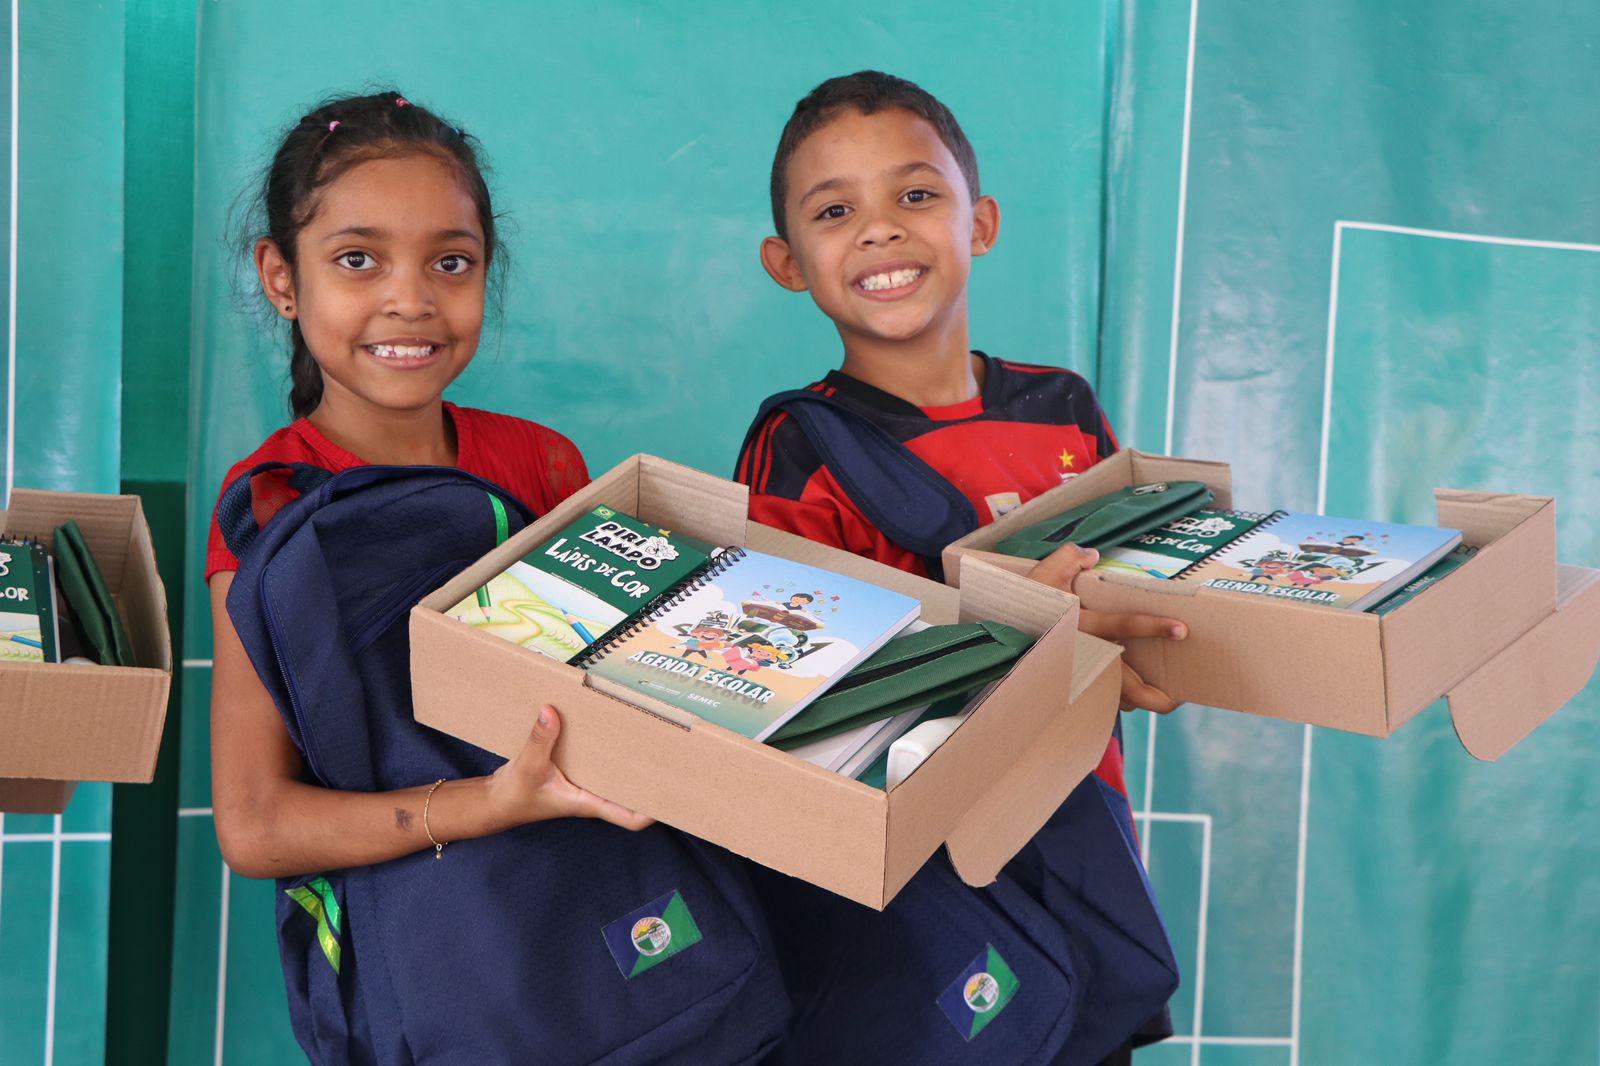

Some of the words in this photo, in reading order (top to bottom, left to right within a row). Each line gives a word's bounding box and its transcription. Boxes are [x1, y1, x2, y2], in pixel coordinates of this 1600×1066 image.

[601, 523, 648, 546] PIRI
[585, 530, 657, 566] LAMPO
[593, 562, 619, 577] DE
[610, 570, 650, 598] COR
[1201, 578, 1265, 594] AGENDA
[1268, 585, 1341, 602] ESCOLAR
[0, 587, 29, 601] OR
[627, 650, 700, 678] AGENDA
[699, 669, 776, 703] ESCOLAR
[687, 692, 721, 708] SEMEC
